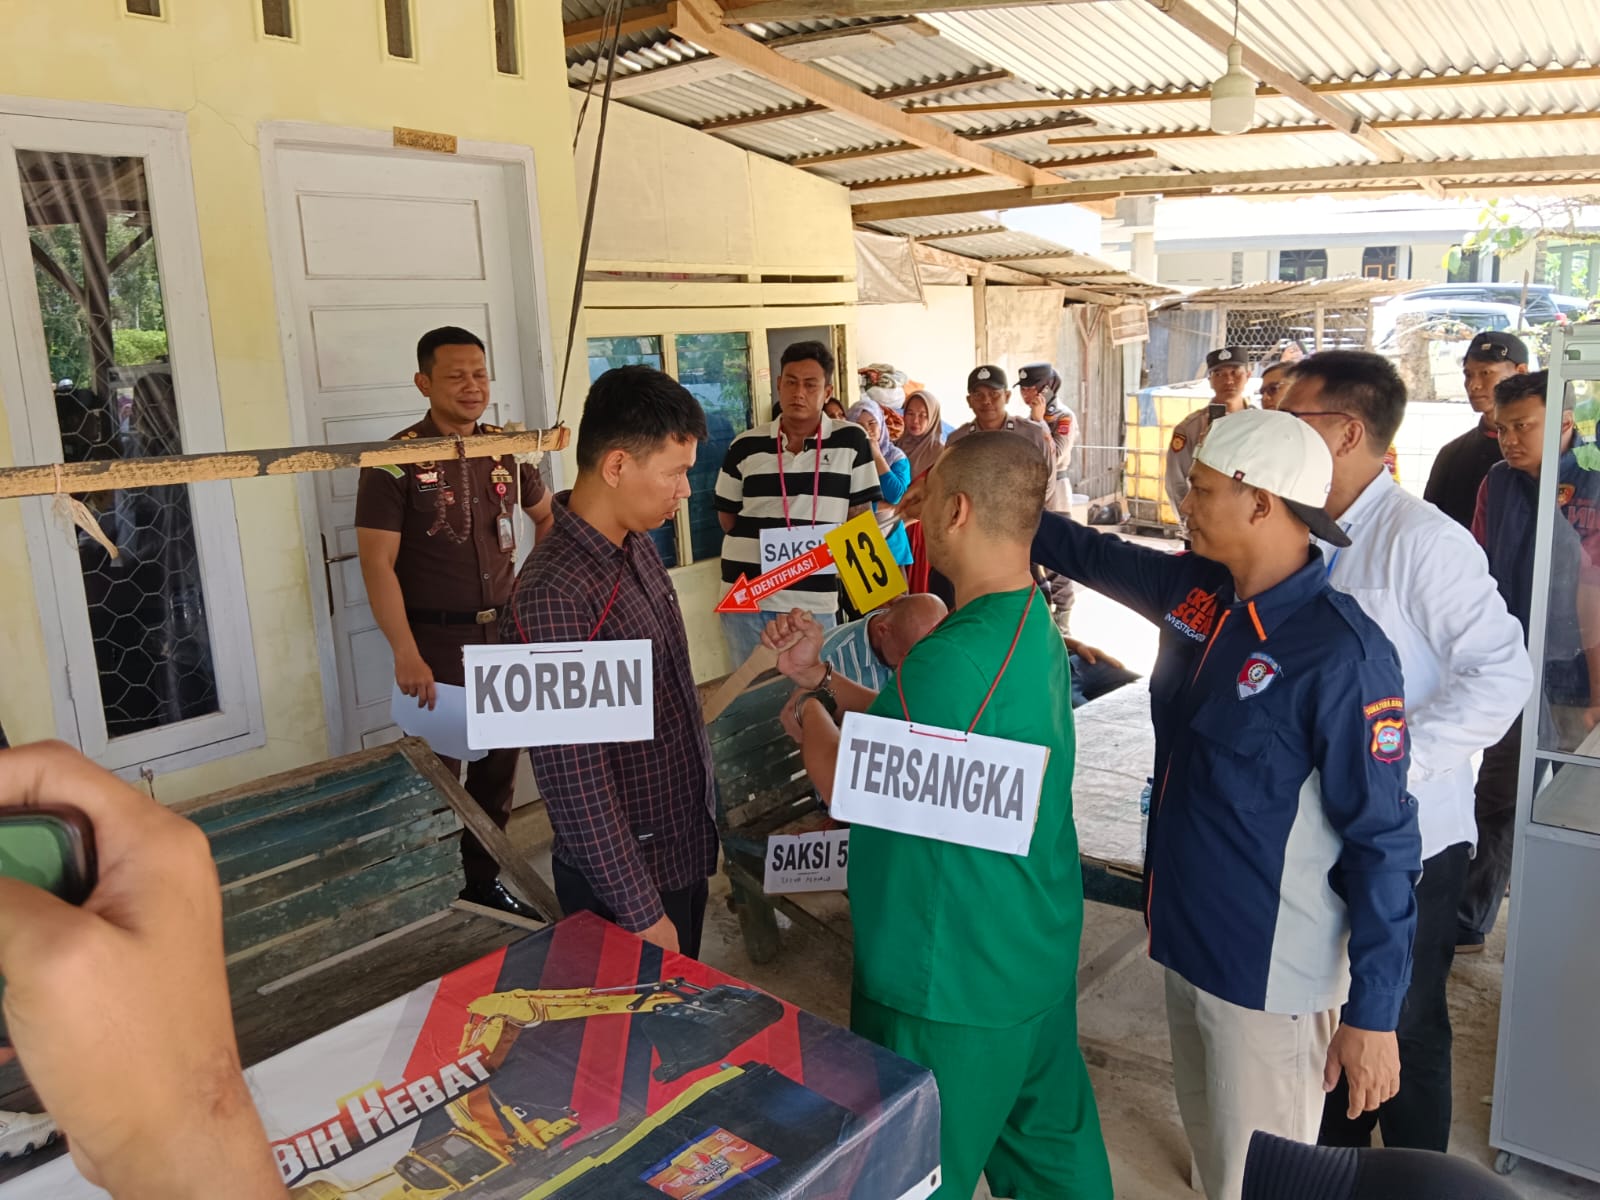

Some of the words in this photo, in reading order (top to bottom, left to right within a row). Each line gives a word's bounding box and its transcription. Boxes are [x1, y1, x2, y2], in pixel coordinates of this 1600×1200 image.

[751, 558, 814, 597] IDENTIFIKASI
[845, 532, 889, 594] 13
[474, 659, 643, 714] KORBAN
[849, 738, 1025, 822] TERSANGKA
[771, 841, 831, 872] SAKSI
[836, 840, 849, 868] 5
[345, 1050, 491, 1144] HEBAT
